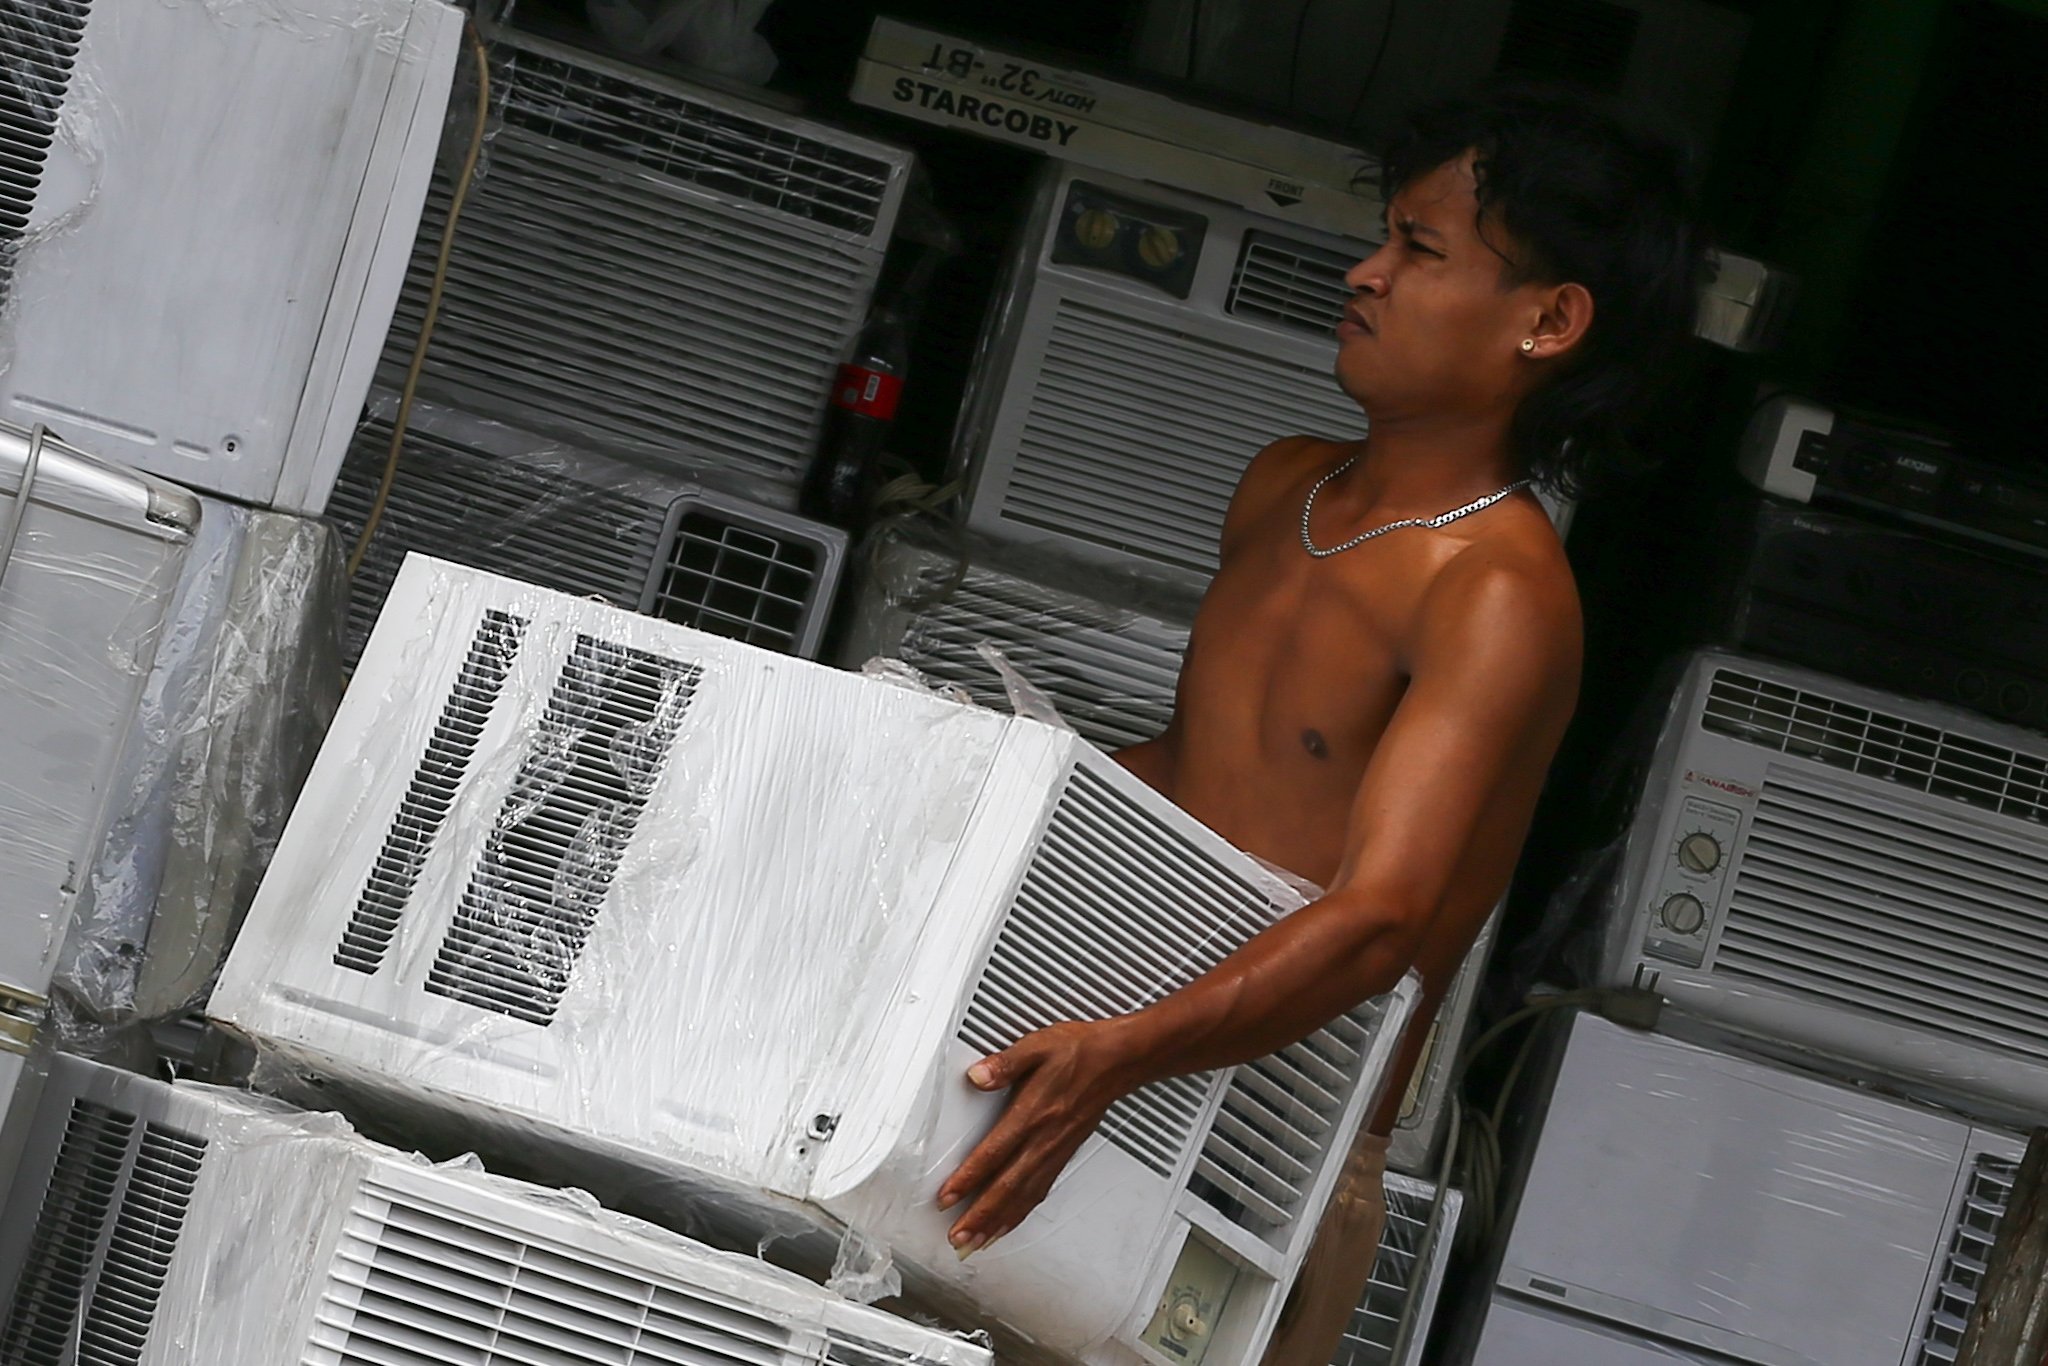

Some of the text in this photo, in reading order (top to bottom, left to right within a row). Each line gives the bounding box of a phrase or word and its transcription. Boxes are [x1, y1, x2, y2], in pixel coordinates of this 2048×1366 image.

[892, 77, 1078, 146] STARCOBY
[1036, 87, 1097, 113] HDTV
[1268, 178, 1304, 197] FRONT
